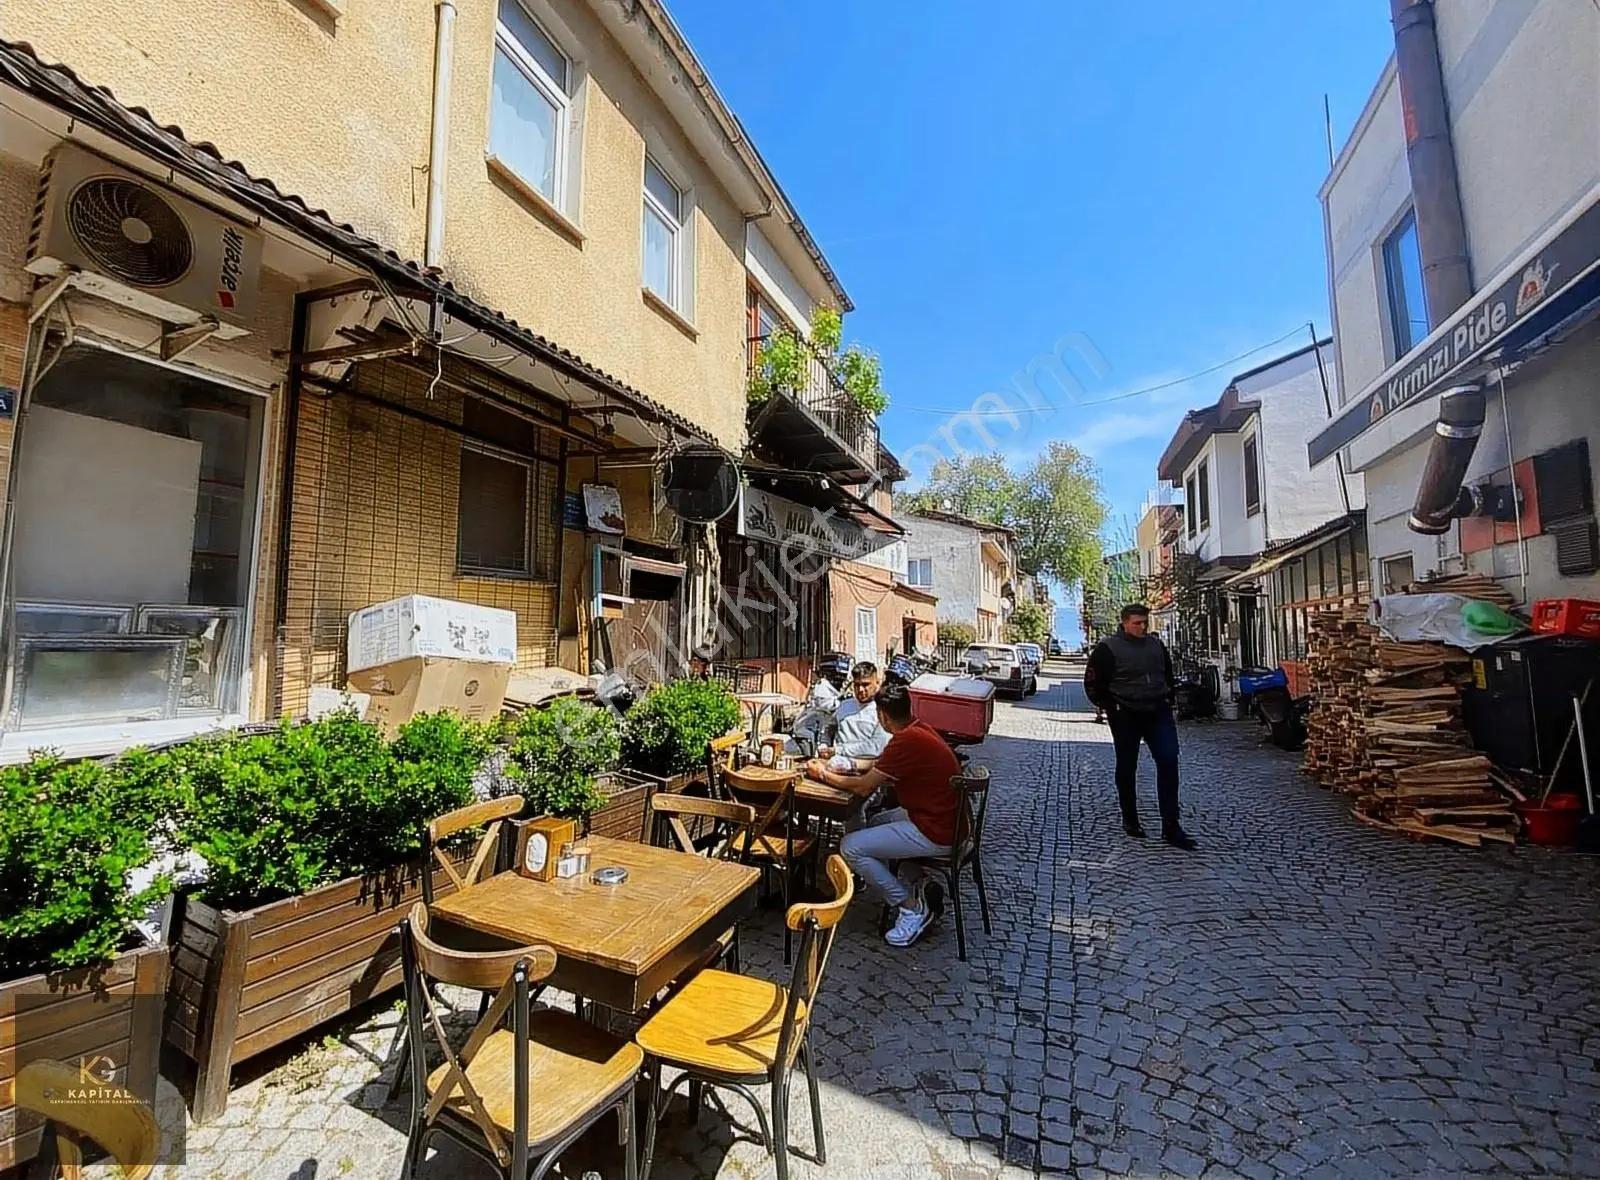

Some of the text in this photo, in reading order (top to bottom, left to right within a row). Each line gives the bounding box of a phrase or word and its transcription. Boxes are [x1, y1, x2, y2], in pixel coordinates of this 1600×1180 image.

[221, 226, 244, 292] arçelik
[1387, 301, 1507, 410] Kırmızı Pide
